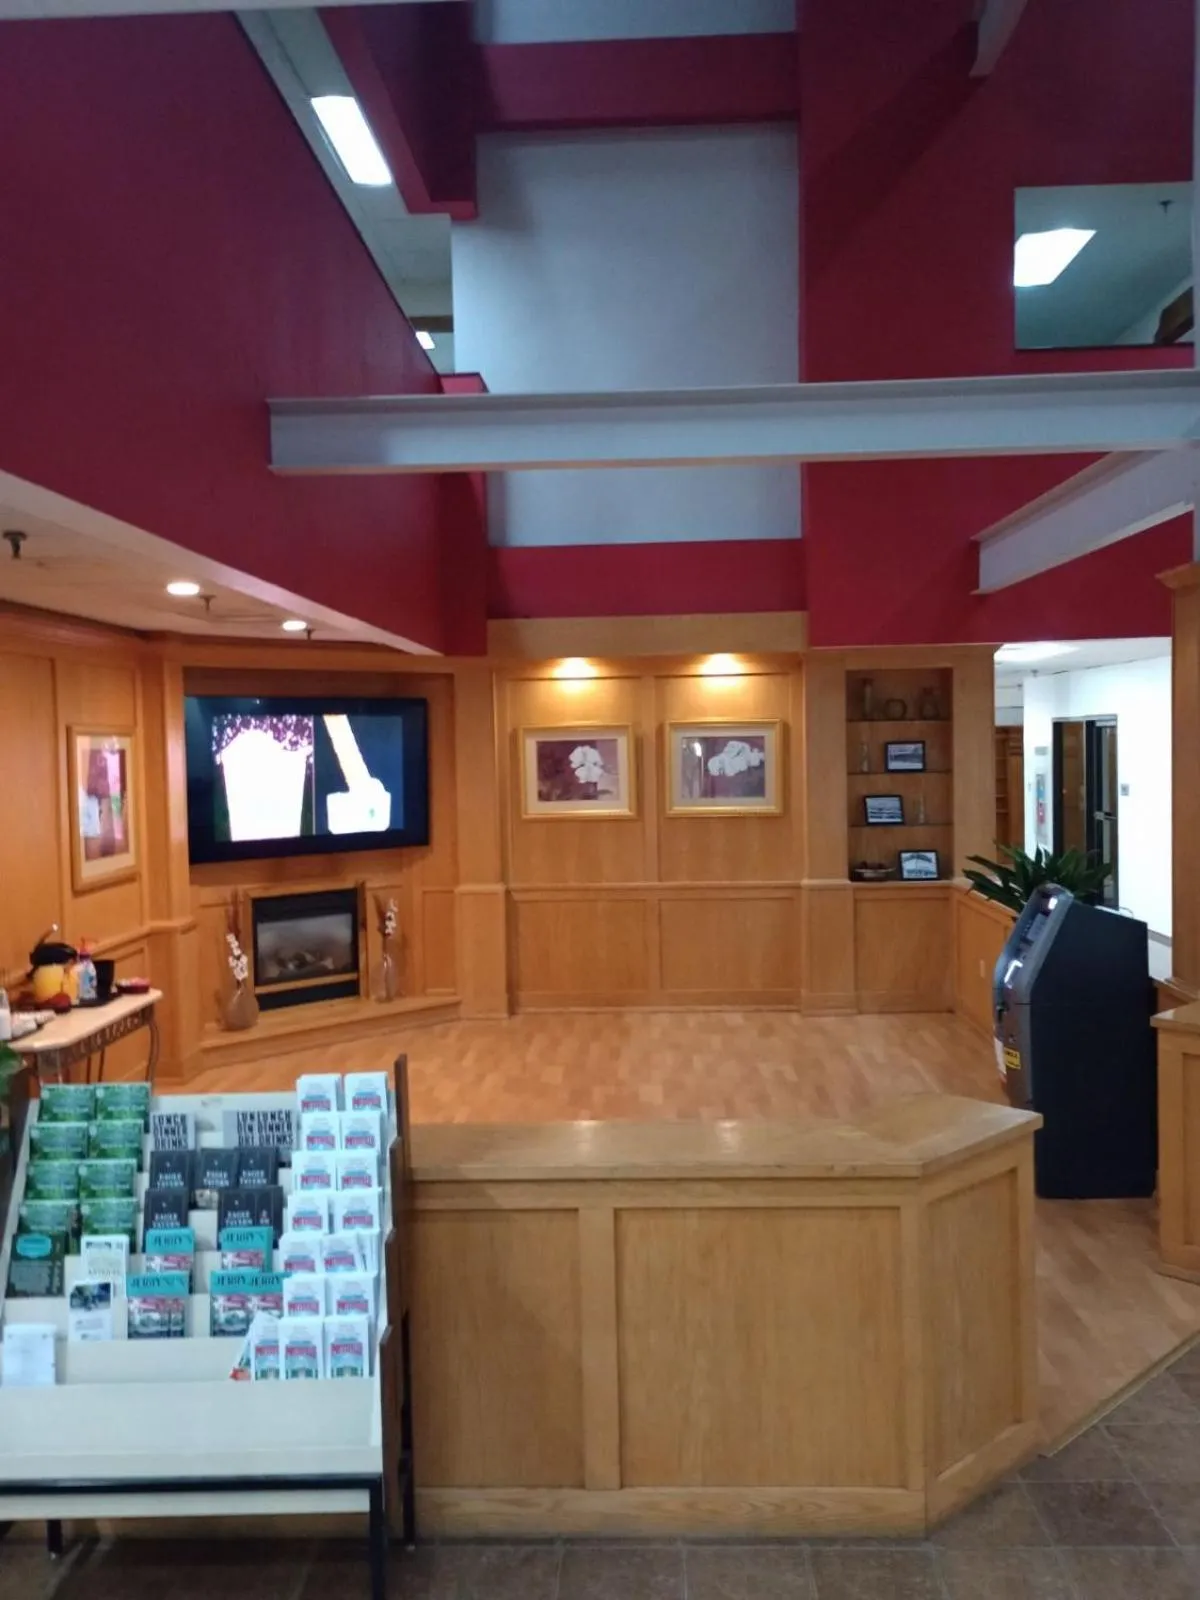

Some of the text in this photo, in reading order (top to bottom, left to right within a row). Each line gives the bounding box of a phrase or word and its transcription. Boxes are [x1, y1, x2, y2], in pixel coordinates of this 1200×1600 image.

[152, 1113, 188, 1125] LUNCH
[257, 1109, 292, 1121] LUNCH
[153, 1125, 188, 1136] DINNER
[257, 1121, 293, 1132] DINNER
[154, 1137, 189, 1149] DRINKS
[258, 1133, 294, 1145] DRINKS
